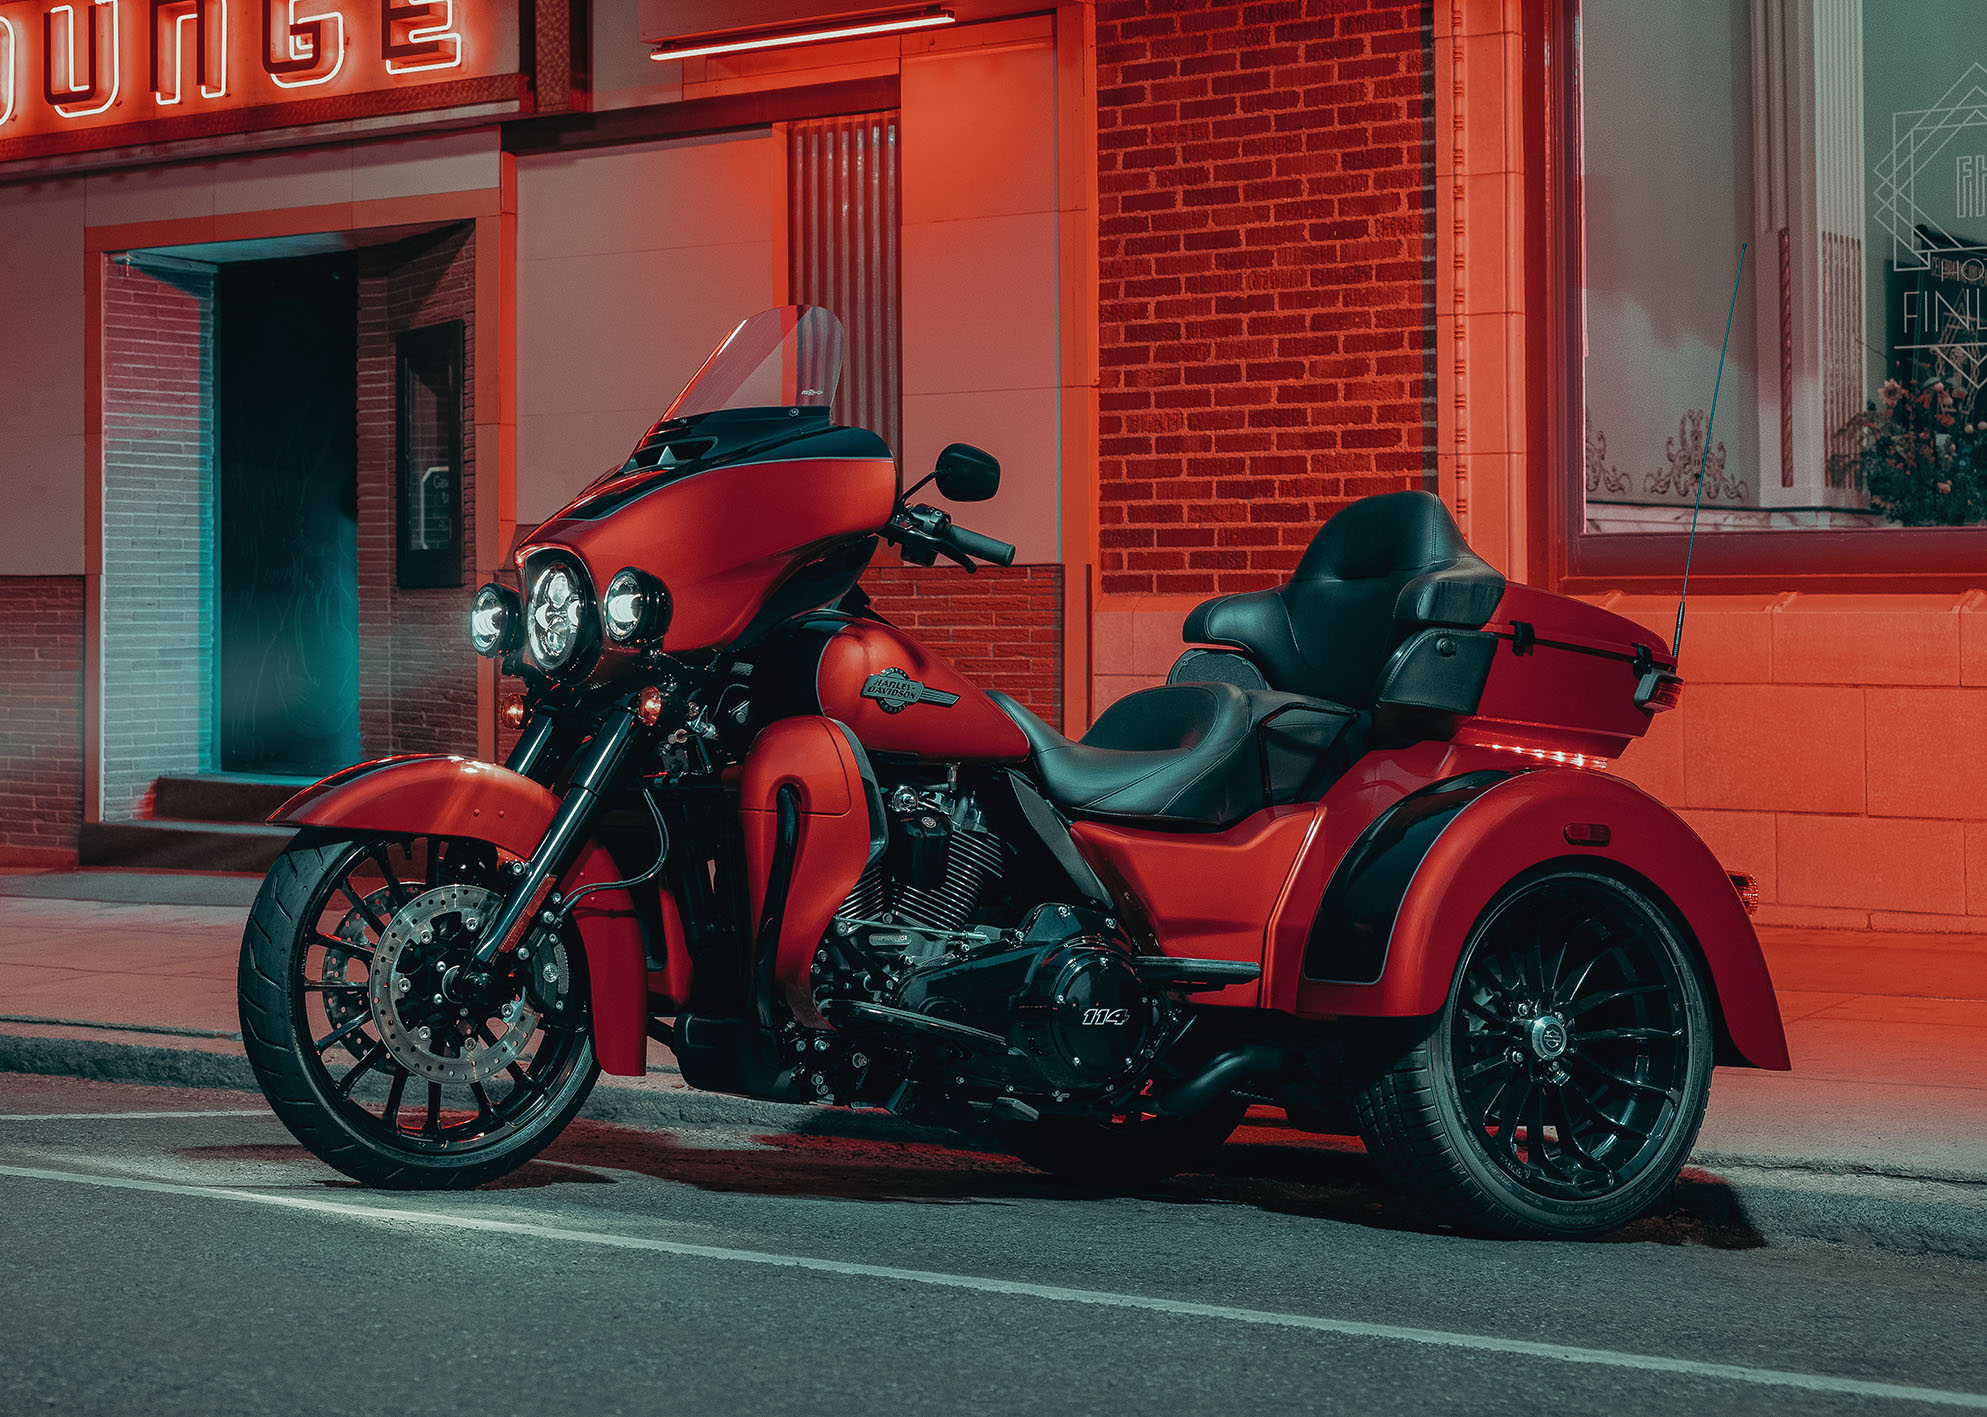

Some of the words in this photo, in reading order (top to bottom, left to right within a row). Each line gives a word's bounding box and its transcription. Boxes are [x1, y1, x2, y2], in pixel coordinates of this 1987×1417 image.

[0, 0, 462, 125] UNGE
[1941, 258, 1987, 281] HO
[867, 686, 917, 699] DAVIDSON
[1082, 1008, 1130, 1026] 114
